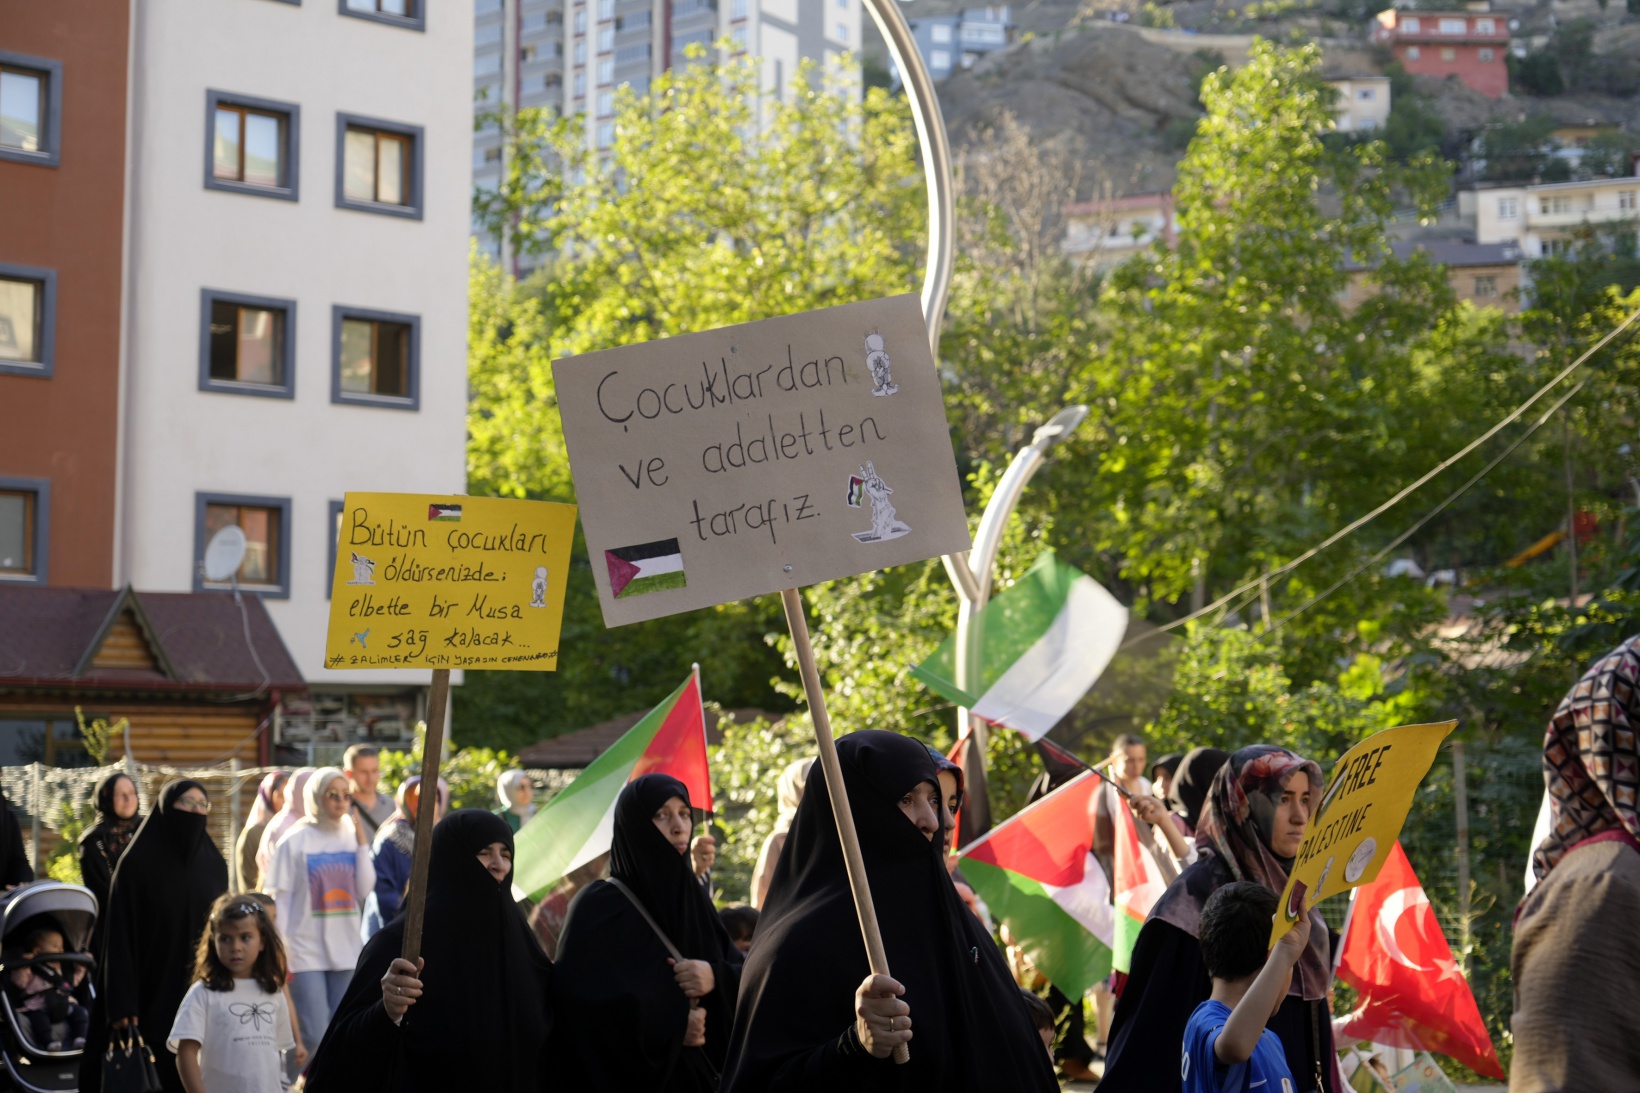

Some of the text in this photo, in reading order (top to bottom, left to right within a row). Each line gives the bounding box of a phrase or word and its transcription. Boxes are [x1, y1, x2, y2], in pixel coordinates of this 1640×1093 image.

[597, 344, 847, 433] Çocuklardan
[618, 408, 886, 489] ve adaletten
[349, 507, 427, 548] Bütün
[349, 592, 523, 619] elbette bir Musa
[387, 629, 429, 658] sağ
[1339, 744, 1392, 800] FREE
[1295, 803, 1372, 872] PALESTINE
